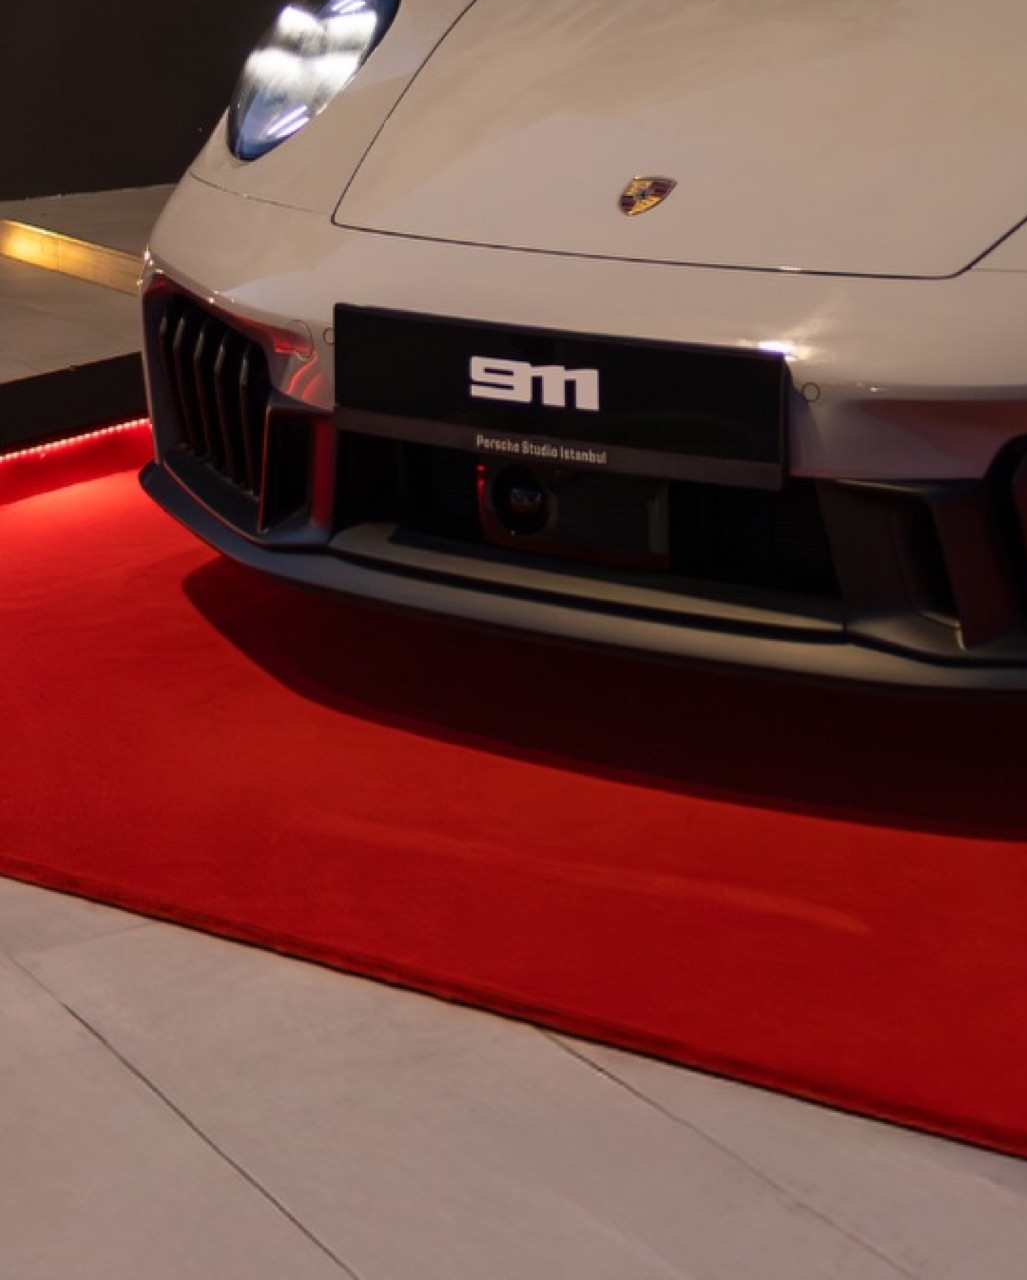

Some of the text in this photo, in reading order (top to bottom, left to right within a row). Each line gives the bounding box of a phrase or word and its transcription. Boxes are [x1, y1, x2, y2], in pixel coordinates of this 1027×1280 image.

[470, 355, 600, 411] 911
[476, 434, 520, 453] Porsche
[522, 440, 558, 458] Studio
